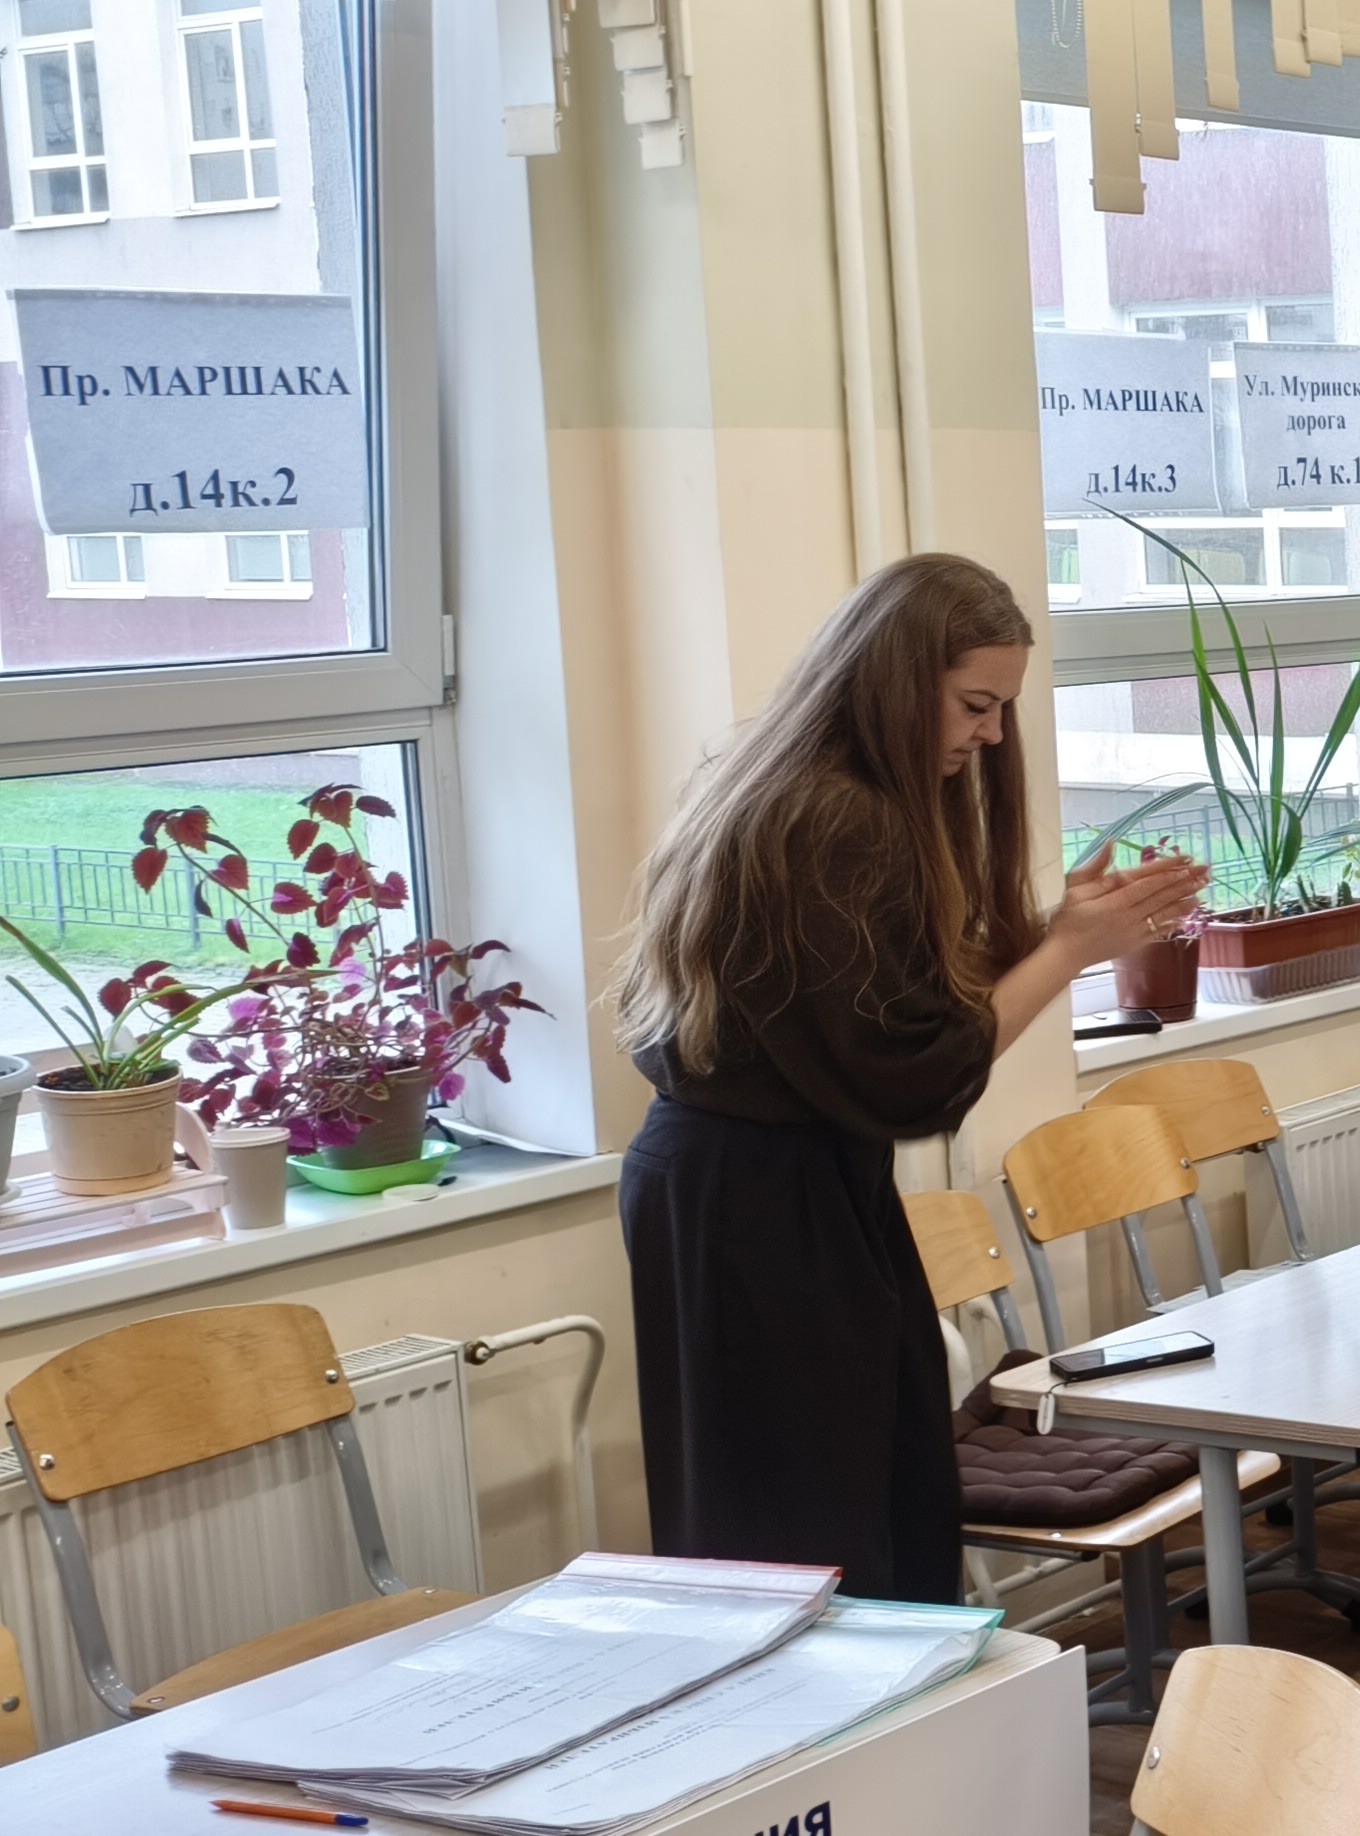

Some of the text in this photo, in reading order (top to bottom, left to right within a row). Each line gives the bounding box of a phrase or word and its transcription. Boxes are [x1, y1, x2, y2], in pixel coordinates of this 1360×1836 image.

[38, 364, 352, 406] Пр. МАРШАКА
[1040, 386, 1205, 416] Пр. МАРШАКА
[1243, 374, 1275, 397] Ул.
[1286, 413, 1346, 436] дорога
[1086, 463, 1177, 497] д.14к.3
[1276, 456, 1322, 491] д.74
[129, 466, 298, 517] д.14к.2
